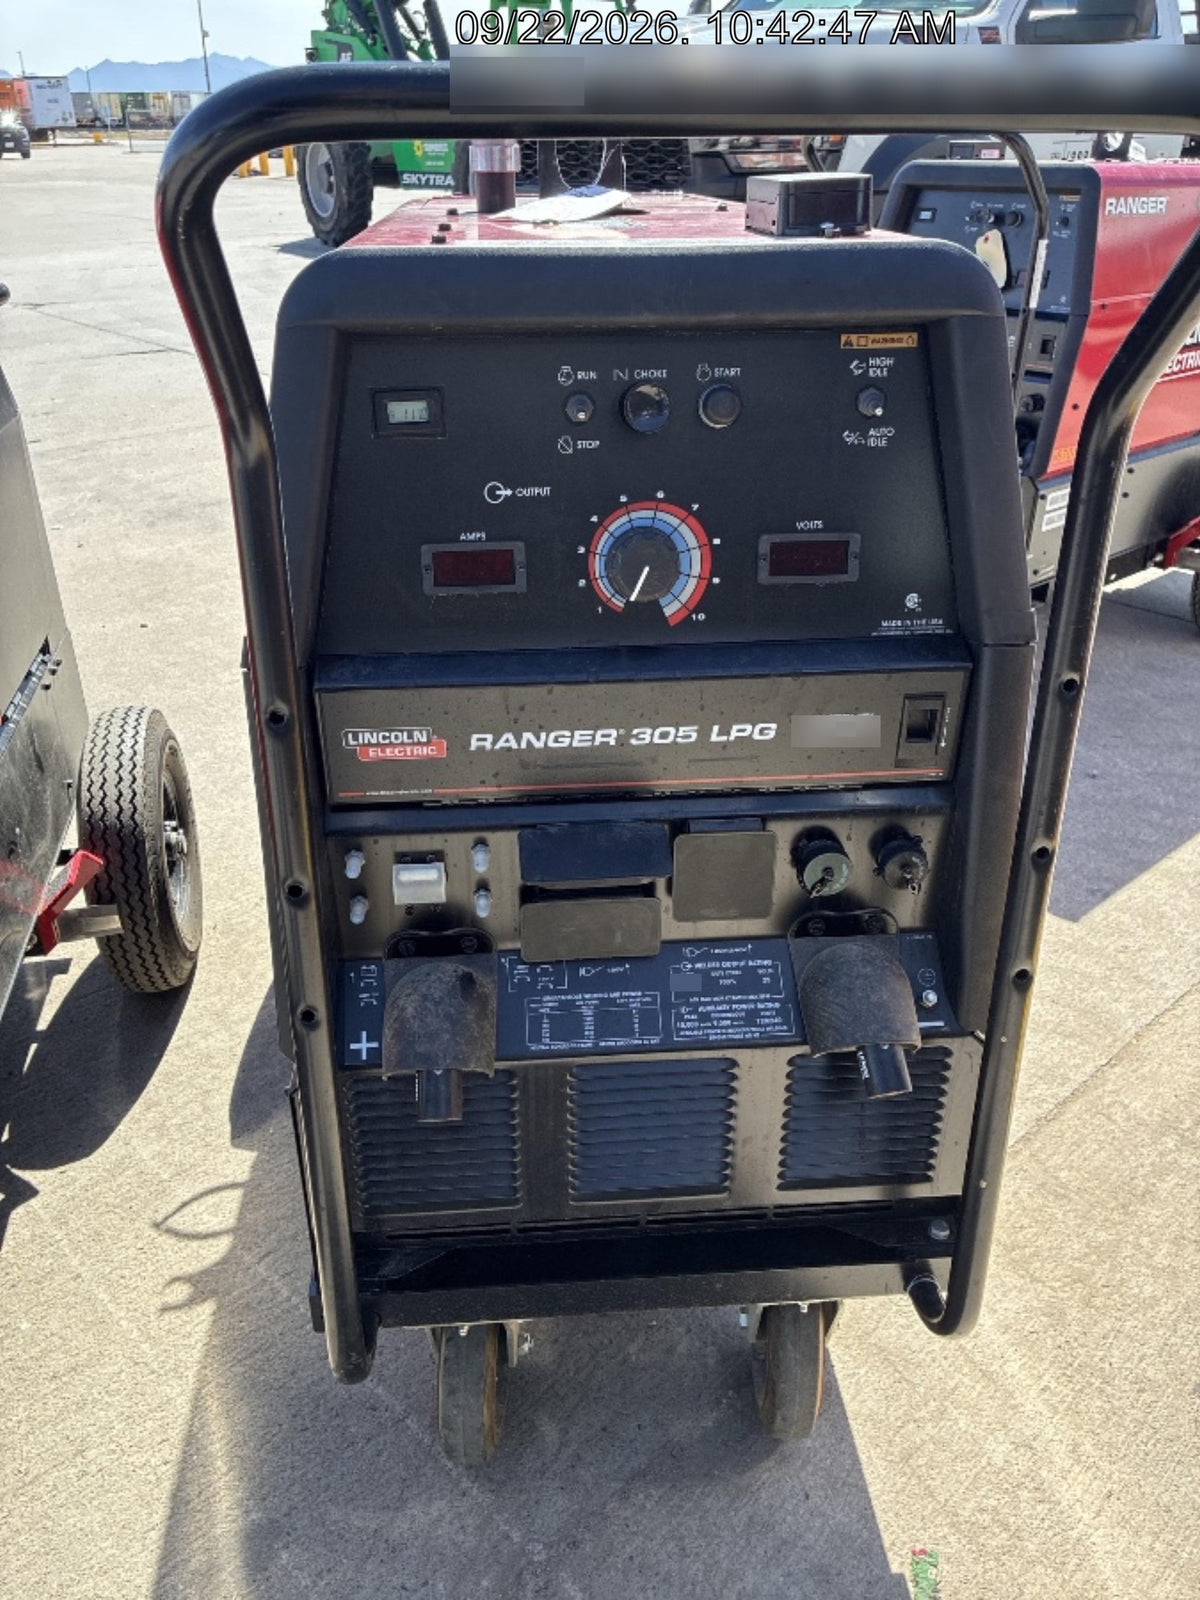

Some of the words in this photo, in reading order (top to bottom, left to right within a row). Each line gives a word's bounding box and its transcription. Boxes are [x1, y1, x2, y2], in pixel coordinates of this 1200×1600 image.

[402, 173, 456, 187] SKYTRA
[1105, 196, 1168, 215] RANGER
[868, 357, 895, 367] HIGH
[577, 370, 597, 380] RUN
[634, 369, 668, 379] CHOKE
[714, 367, 741, 378] START
[868, 368, 888, 377] IDLE
[868, 426, 895, 437] AUTO
[577, 440, 600, 450] STOP
[867, 437, 888, 447] IDLE
[515, 486, 552, 497] OUTPUT
[656, 490, 665, 499] 6
[691, 503, 699, 512] 7
[795, 520, 824, 531] VOLTS
[460, 531, 487, 541] AMPS
[691, 612, 706, 621] 10
[348, 729, 428, 746] LINCOLN
[468, 728, 618, 752] RANGER
[629, 725, 699, 746] 305
[709, 723, 778, 742] LPG
[368, 745, 438, 758] ELECTRIC
